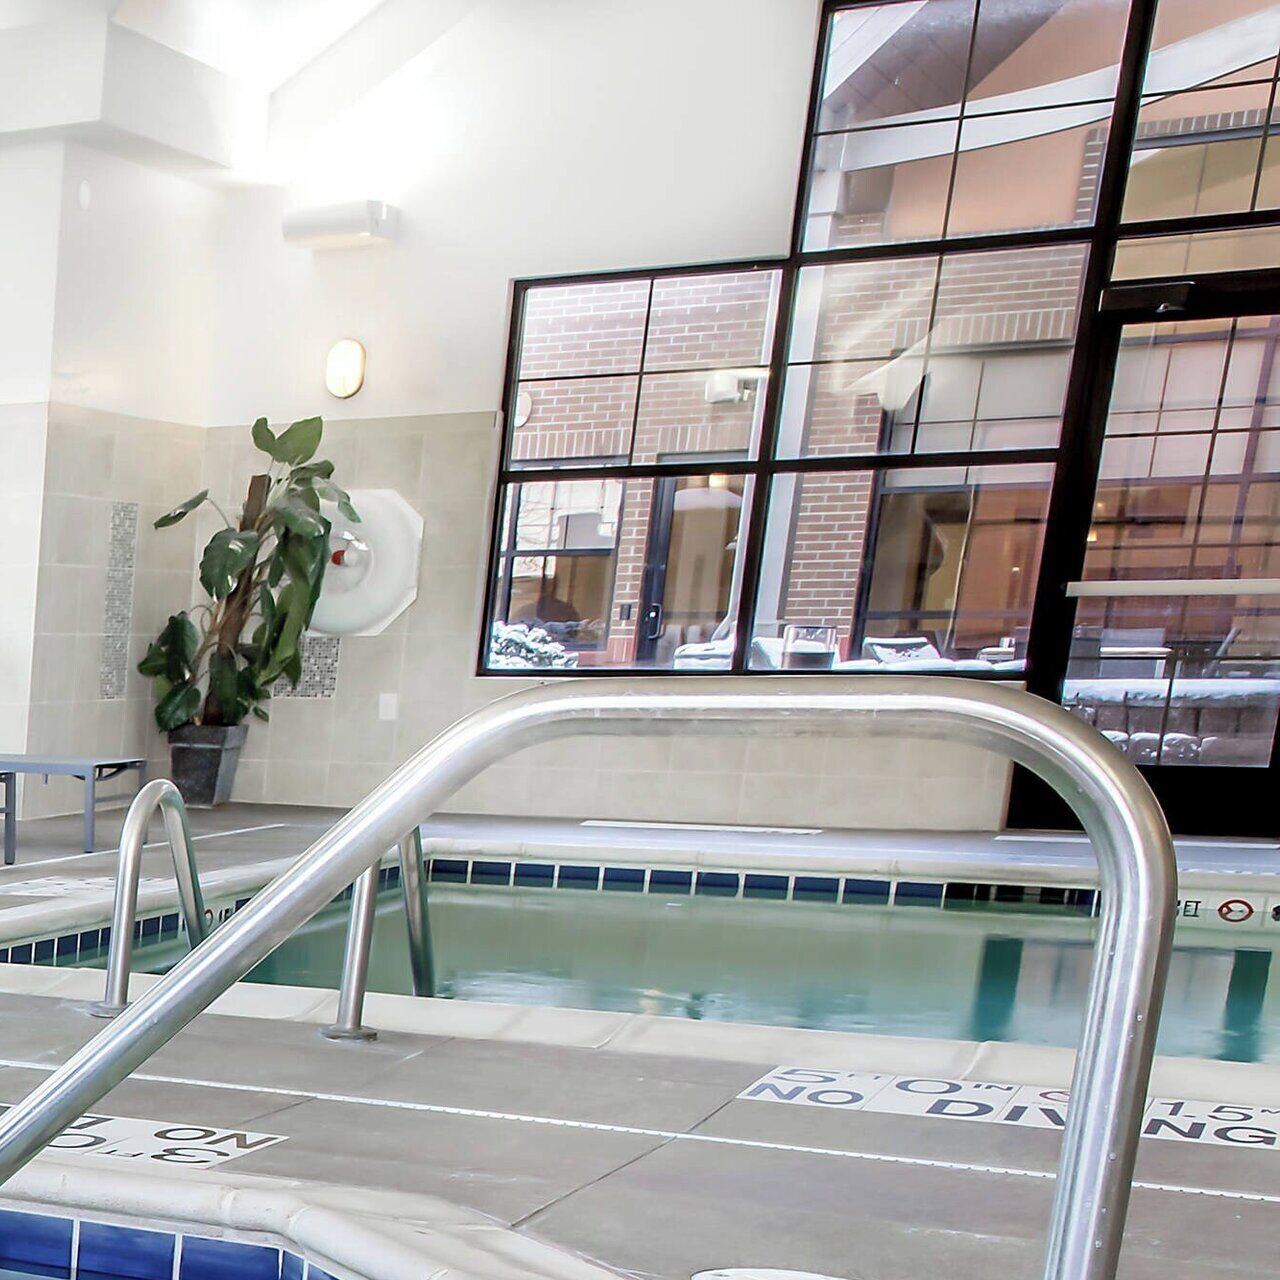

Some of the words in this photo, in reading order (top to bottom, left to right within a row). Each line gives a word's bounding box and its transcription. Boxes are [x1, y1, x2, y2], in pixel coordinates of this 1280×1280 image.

[746, 1082, 864, 1105] NO
[925, 1098, 1278, 1146] DIVNG
[154, 1127, 279, 1149] NO
[150, 1147, 230, 1164] 3
